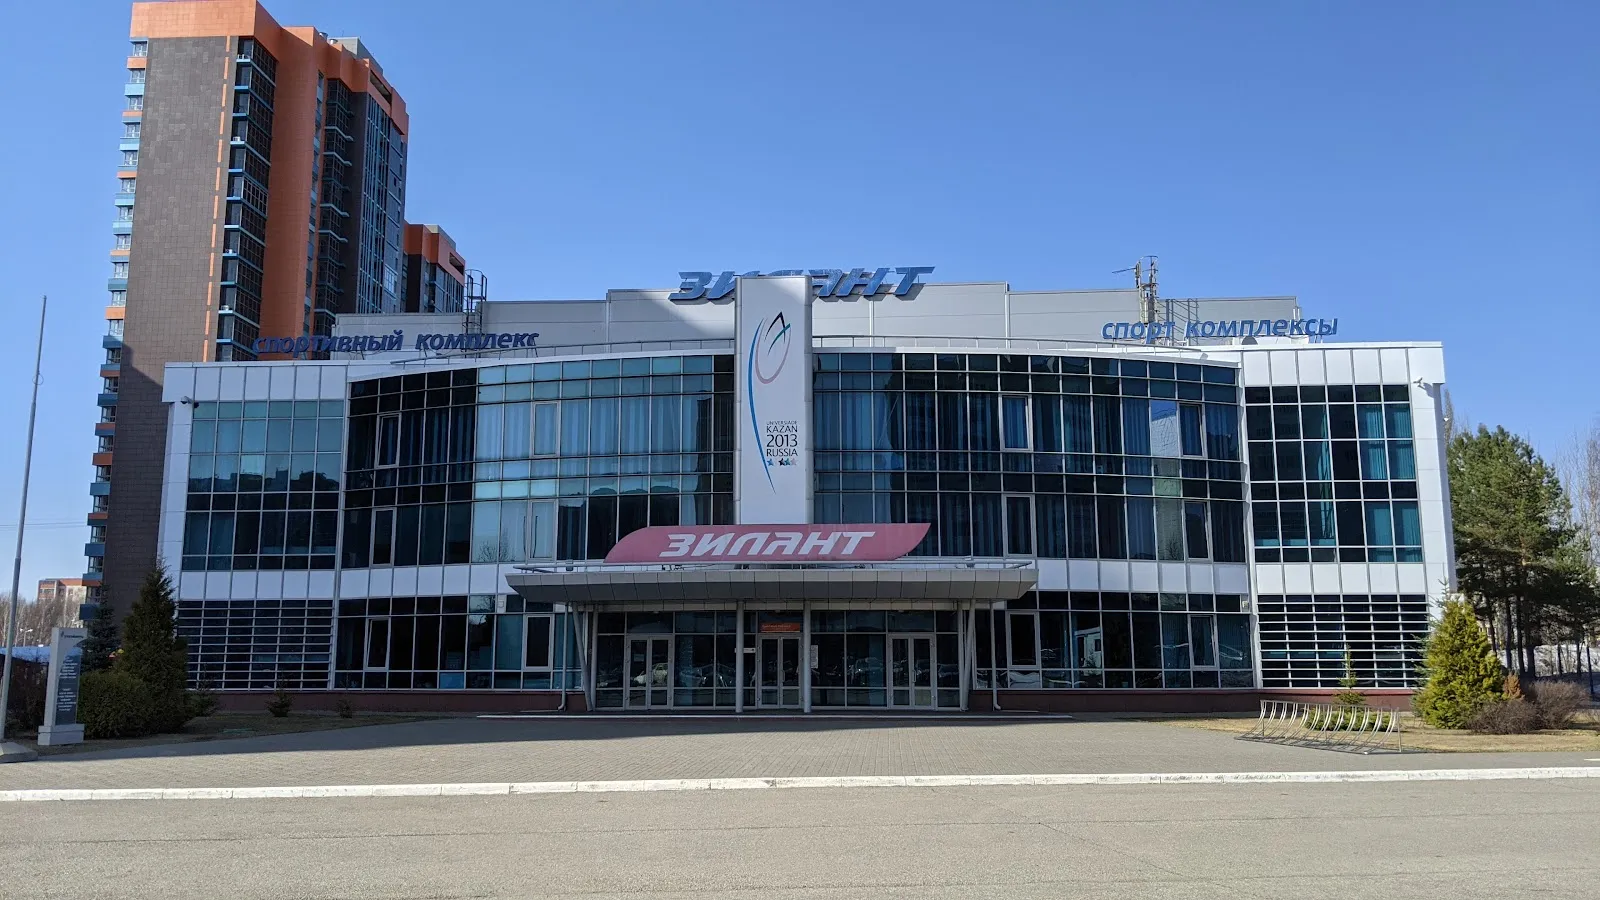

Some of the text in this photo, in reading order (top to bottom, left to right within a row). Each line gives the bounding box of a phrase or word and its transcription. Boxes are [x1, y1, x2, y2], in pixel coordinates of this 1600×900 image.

[668, 267, 935, 300] ЗИАНТ
[251, 330, 539, 357] спортивный комплекс
[1102, 318, 1338, 344] спорт комплексы
[766, 425, 798, 433] KAZAN
[766, 434, 798, 447] 2013
[766, 448, 798, 457] RUSSIA
[659, 531, 876, 558] ЗИЛАНТ
